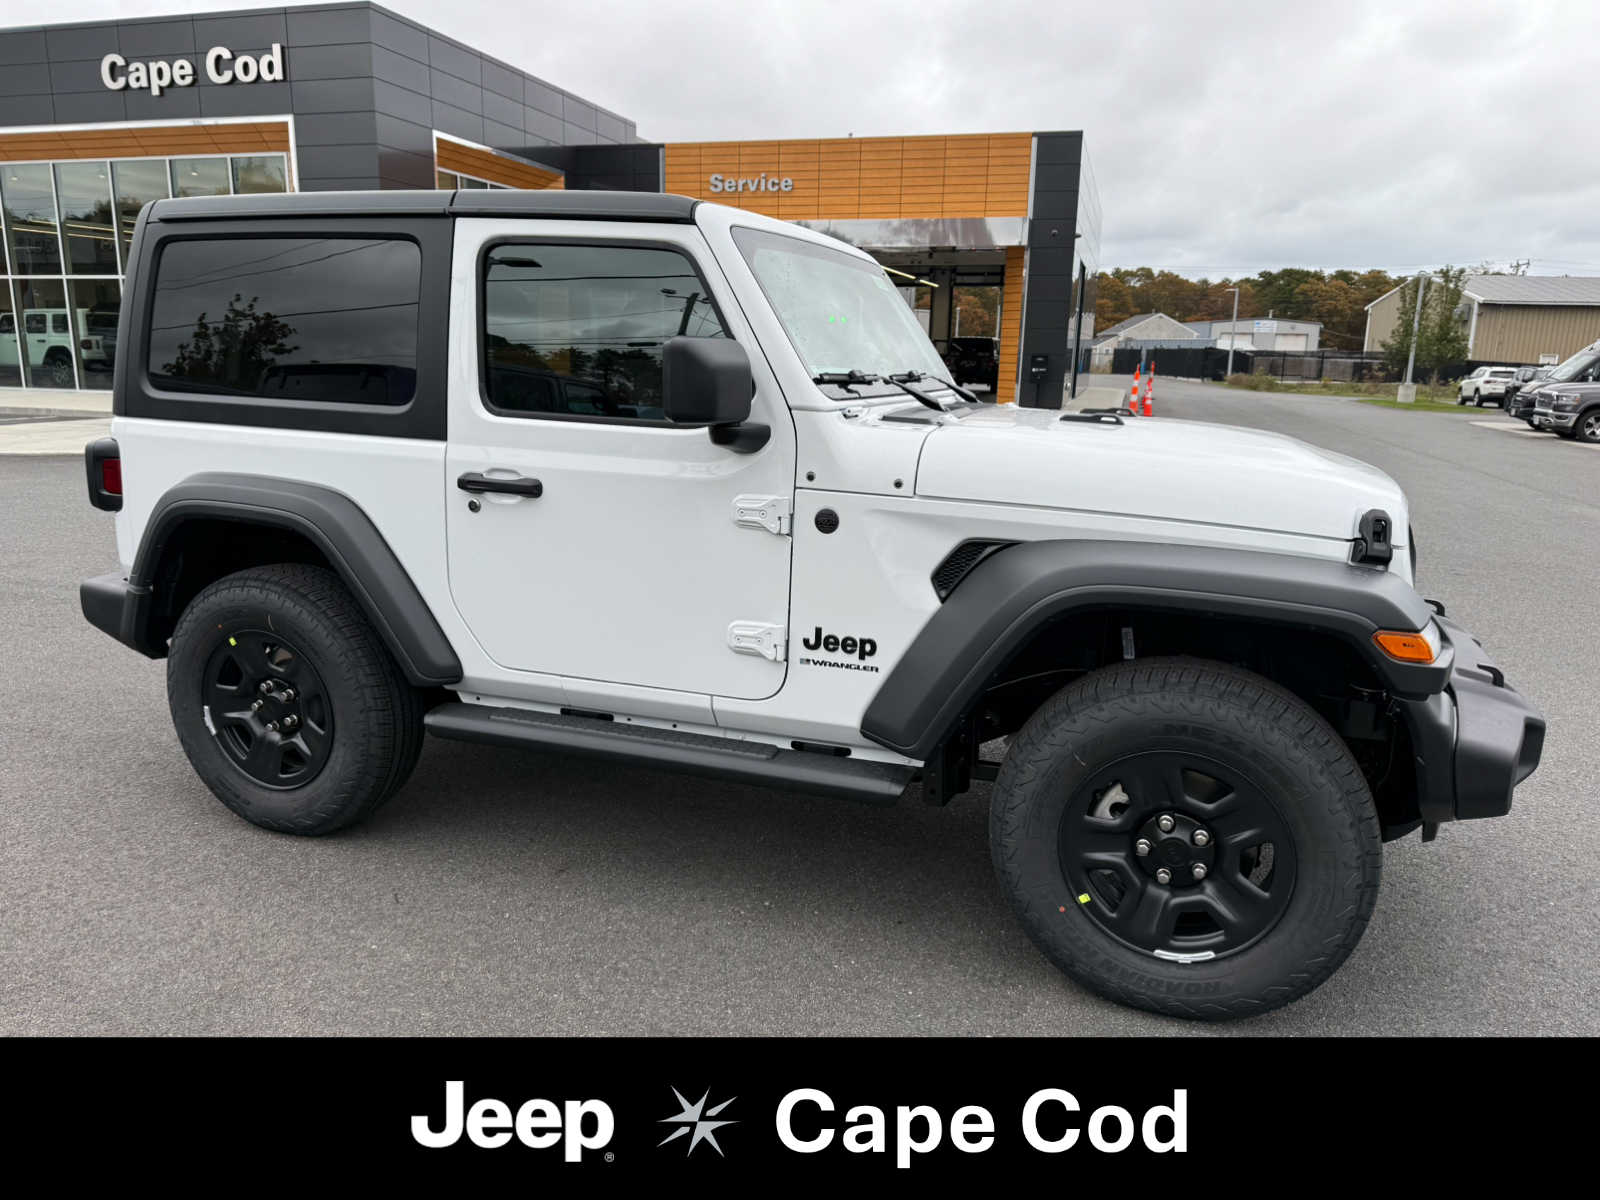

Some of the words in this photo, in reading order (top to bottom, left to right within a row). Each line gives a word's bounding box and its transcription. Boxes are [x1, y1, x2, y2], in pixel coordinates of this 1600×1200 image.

[100, 53, 193, 96] Cape
[205, 42, 284, 84] Cod
[708, 172, 793, 193] Service
[802, 626, 877, 660] Jeep
[811, 658, 879, 673] WRANGLER
